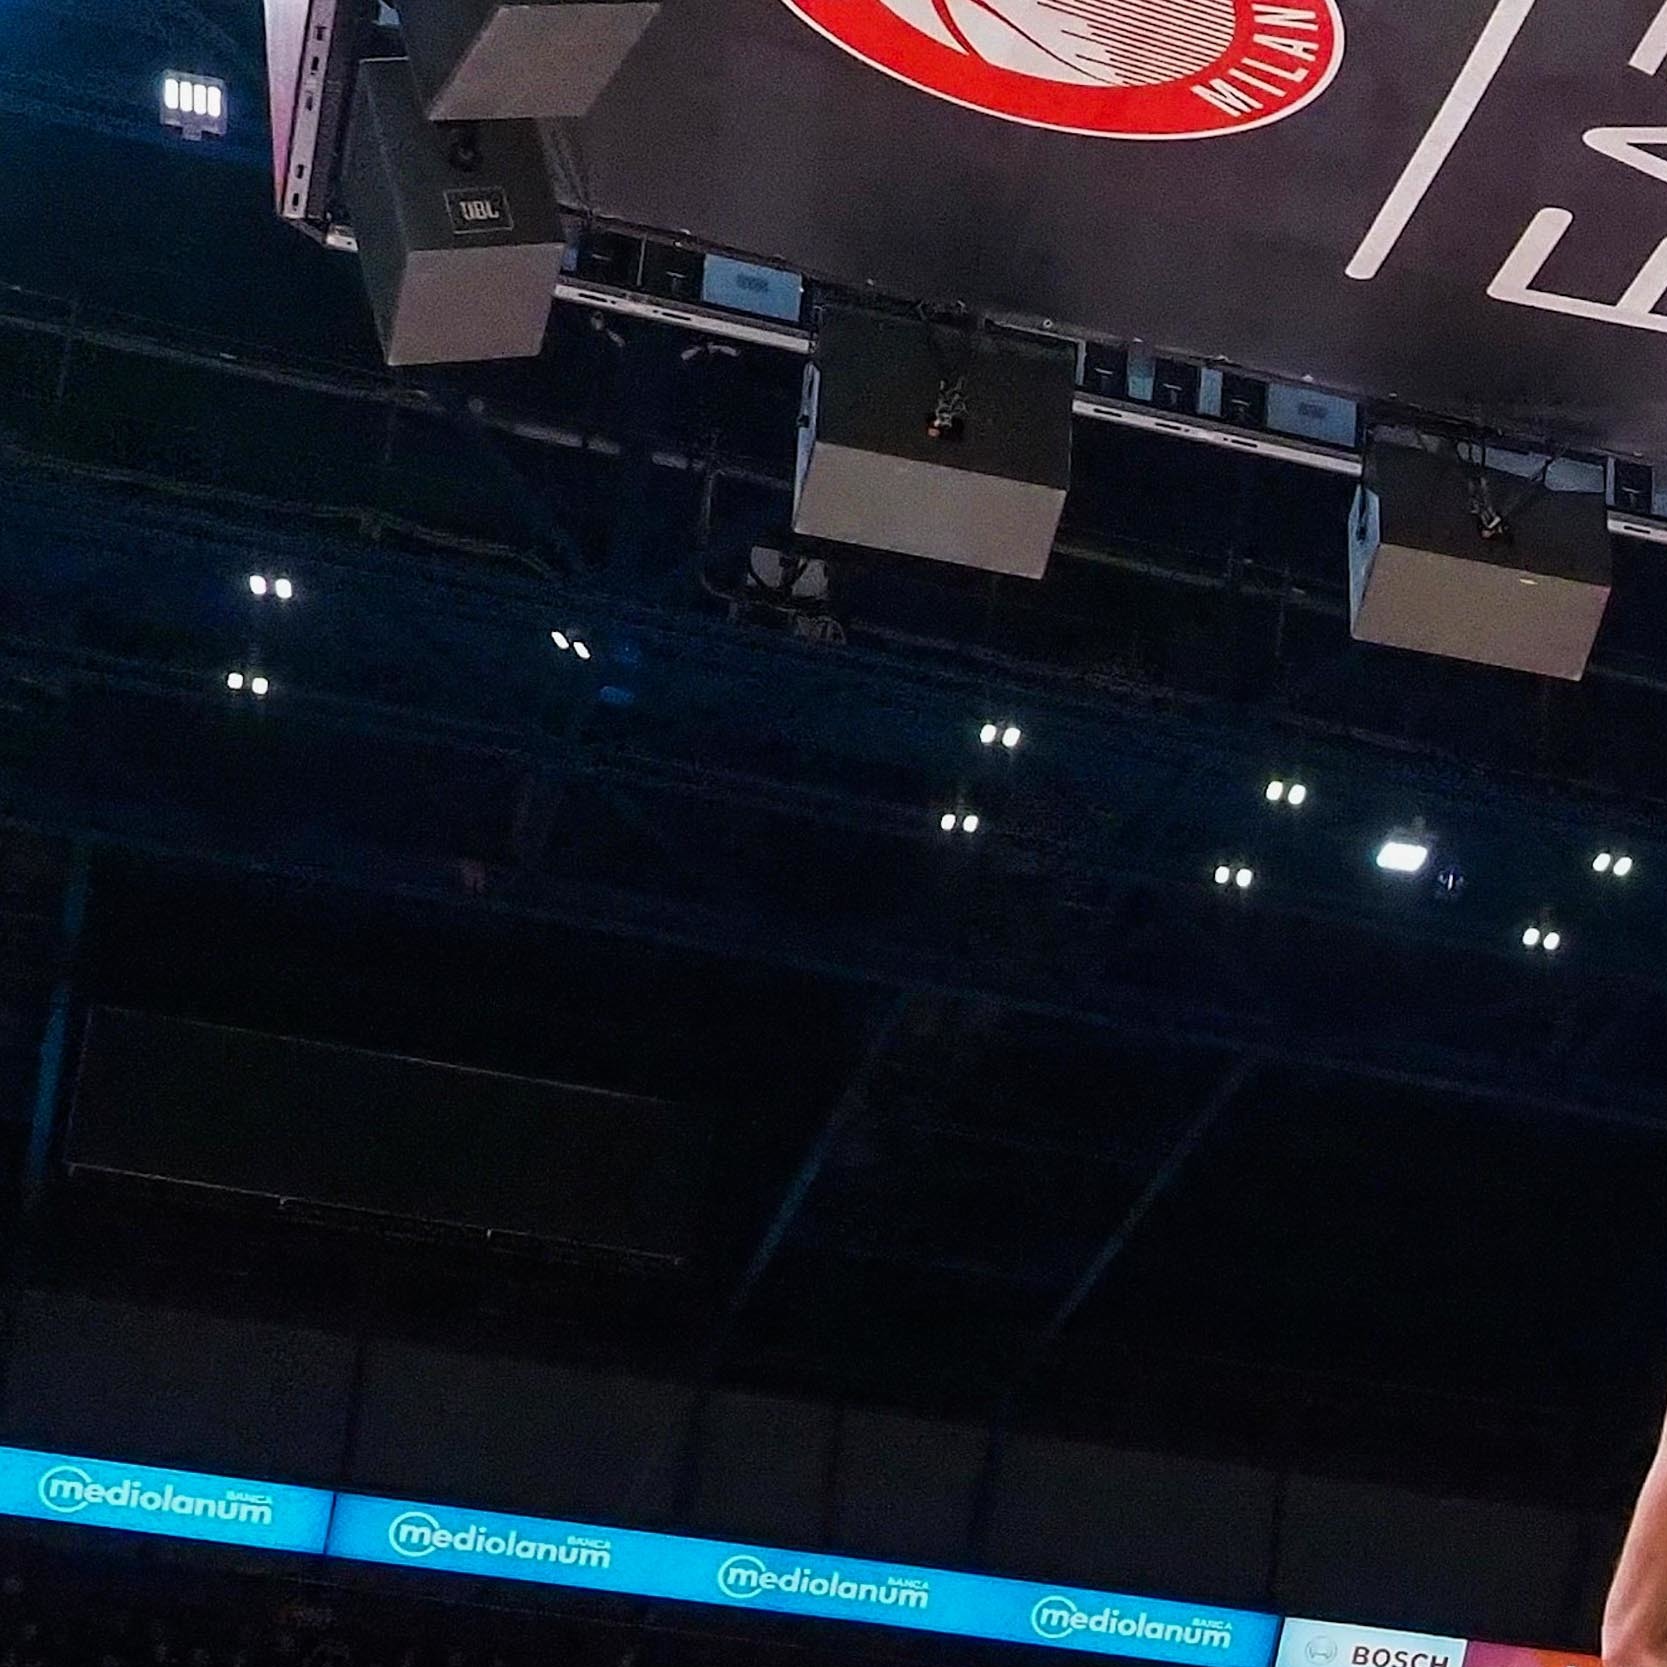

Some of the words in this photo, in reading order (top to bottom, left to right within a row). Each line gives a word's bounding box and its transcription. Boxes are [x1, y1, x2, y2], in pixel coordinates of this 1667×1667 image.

[43, 1470, 273, 1526] mediolanum
[393, 1515, 612, 1569] mediolanum
[722, 1560, 929, 1610] mediolanum
[1035, 1599, 1232, 1649] mediolanum
